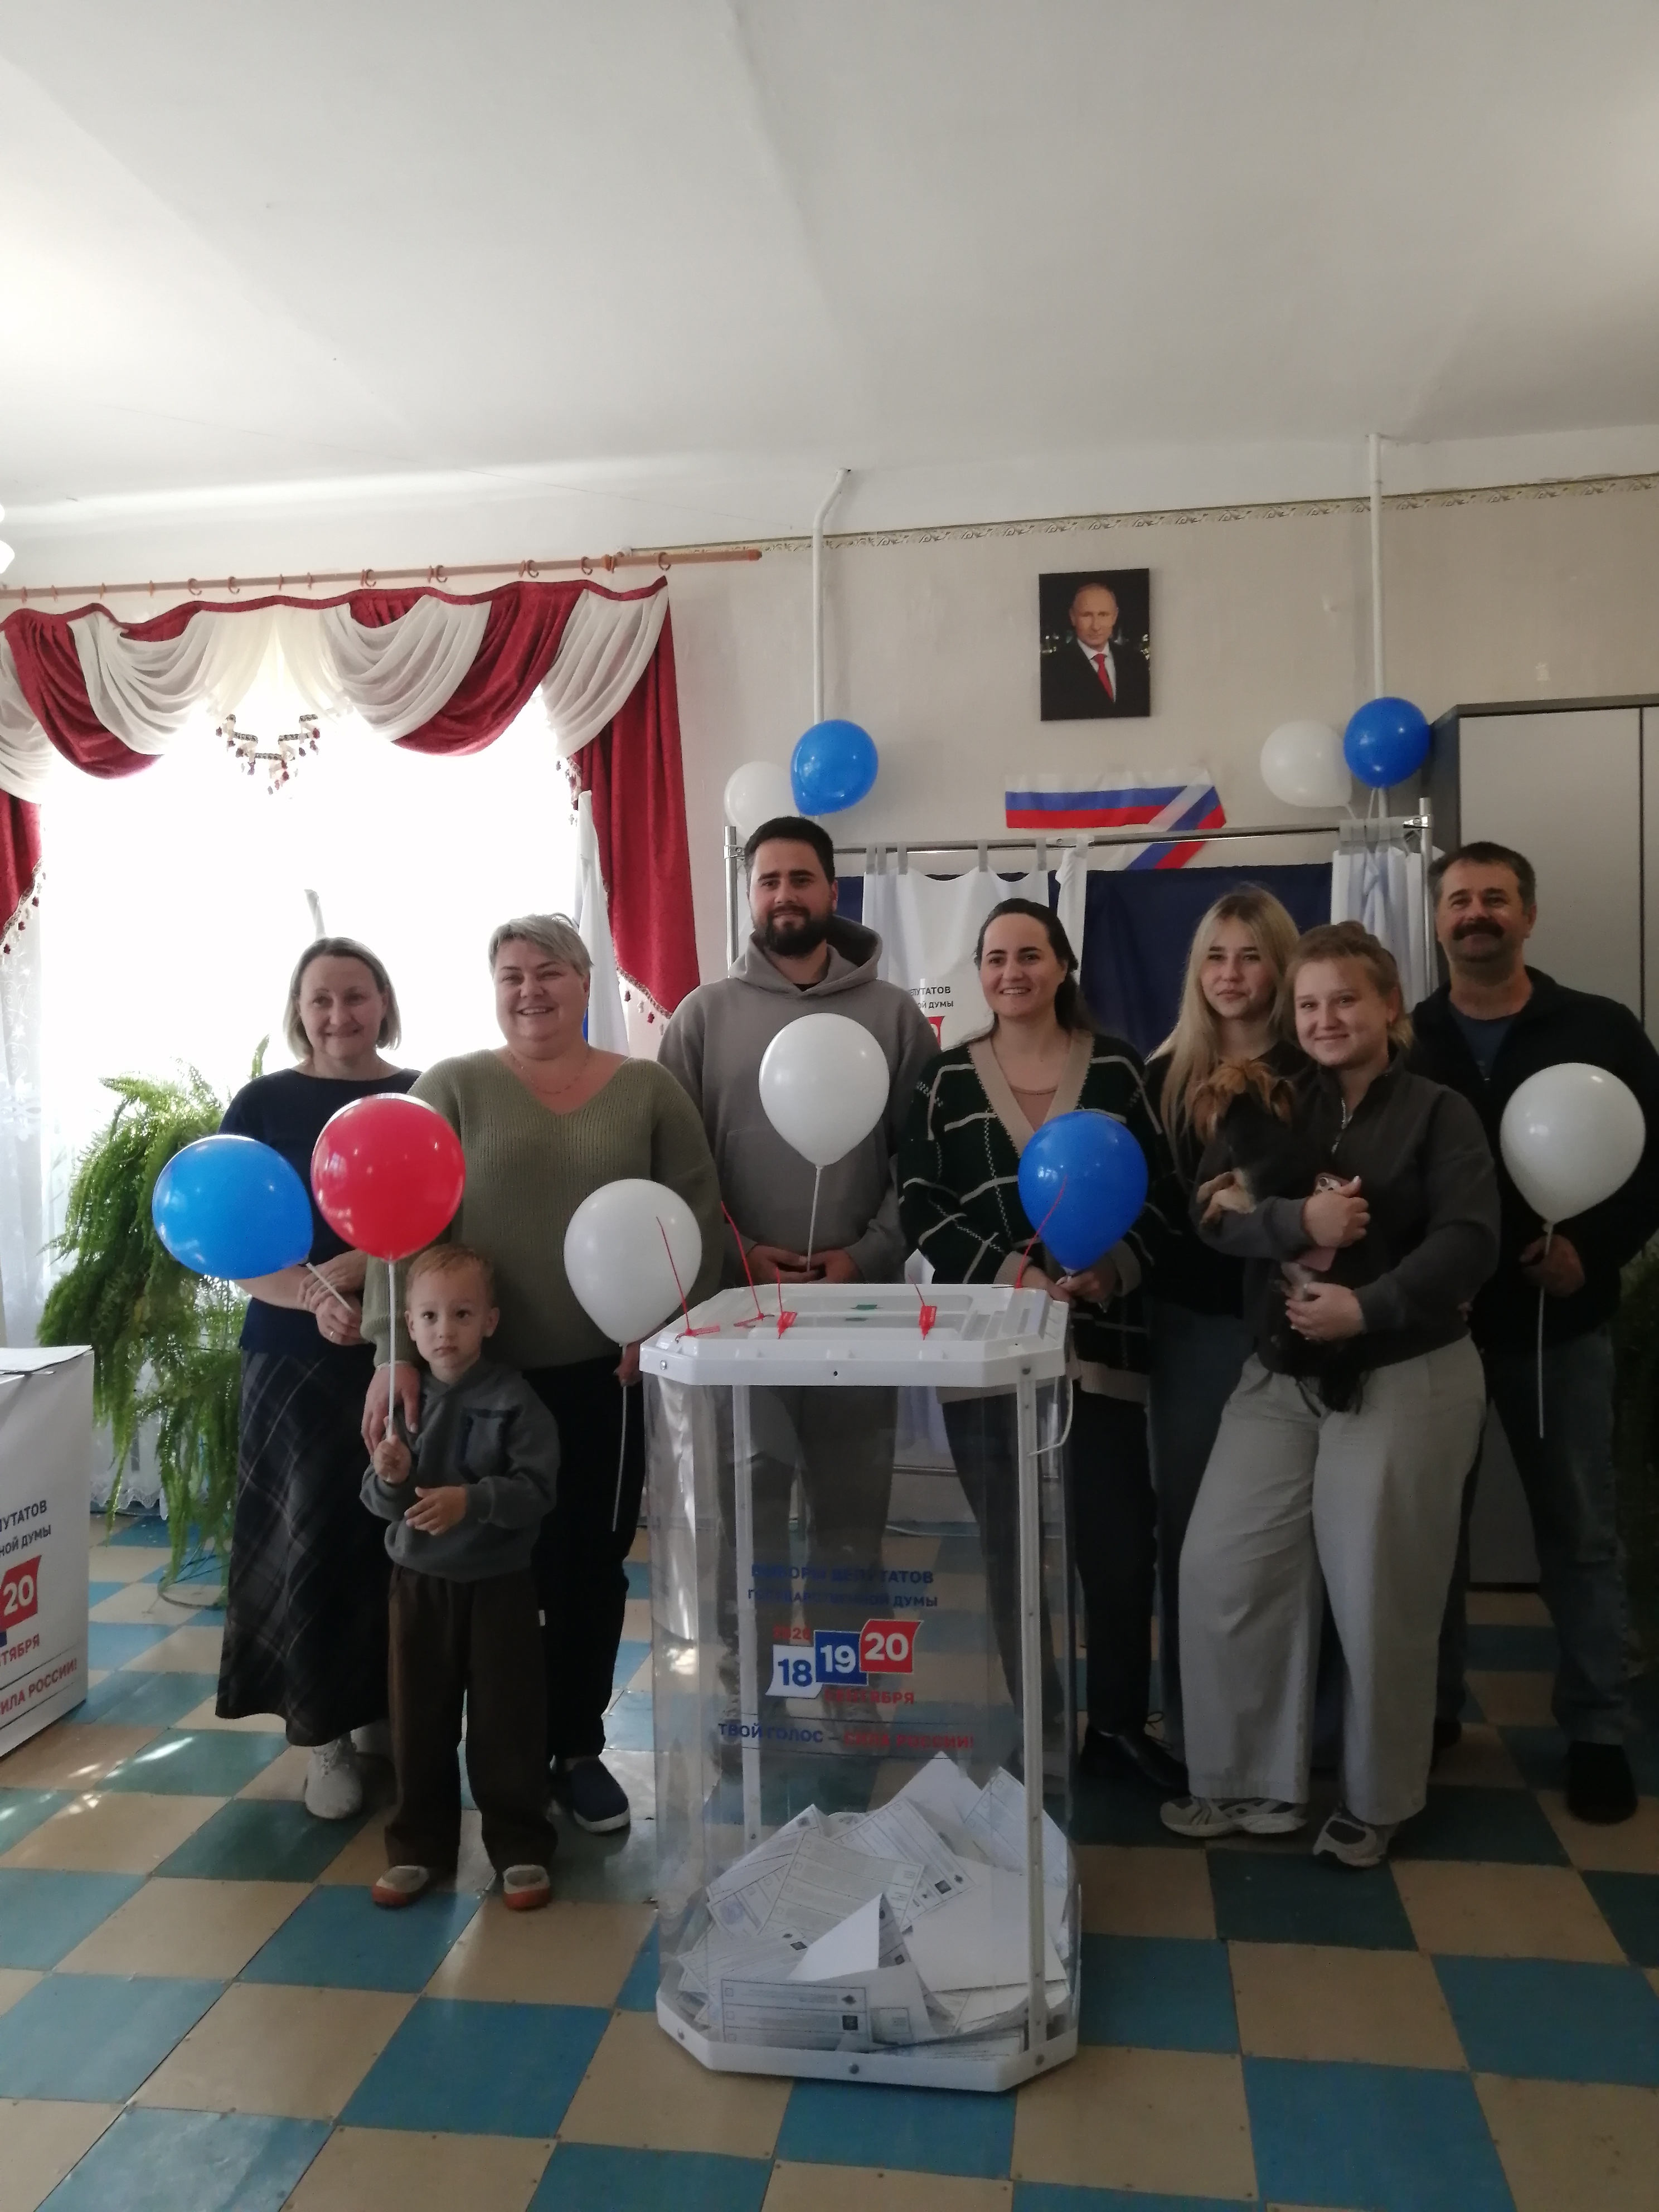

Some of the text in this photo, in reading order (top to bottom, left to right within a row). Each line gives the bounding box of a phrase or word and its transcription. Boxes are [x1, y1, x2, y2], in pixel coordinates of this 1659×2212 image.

[929, 1001, 954, 1009] ДУМЫ
[21, 1525, 51, 1550] ДУМЫ
[3, 1574, 35, 1616] 20
[893, 1595, 938, 1608] ДУМЫ
[0, 1633, 40, 1666] ТЯБРЯ
[778, 1633, 909, 1687] 18 19 20
[28, 1658, 77, 1697] РОССИИ!
[824, 1689, 915, 1705] СЕНТЯБРЯ
[719, 1722, 762, 1738] ТВОЙ
[769, 1727, 823, 1742] ГОЛОС
[843, 1733, 890, 1748] СИЛА
[896, 1734, 974, 1749] РОССИИ!
